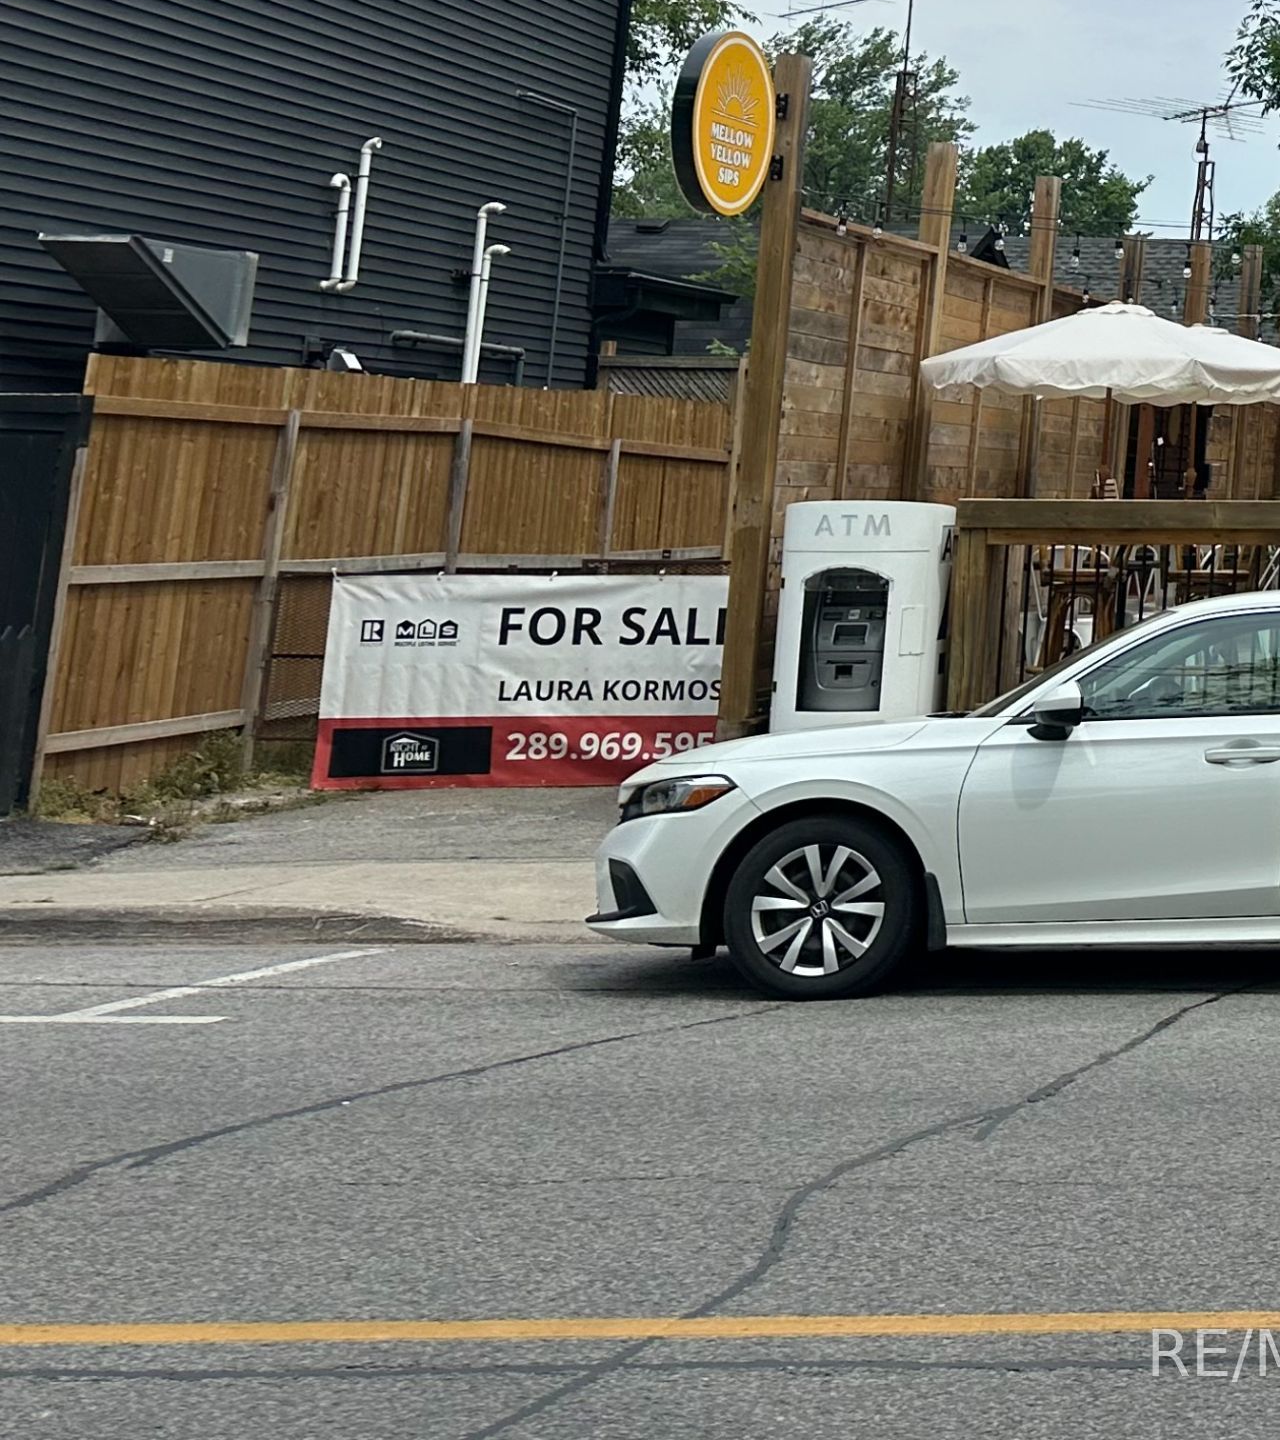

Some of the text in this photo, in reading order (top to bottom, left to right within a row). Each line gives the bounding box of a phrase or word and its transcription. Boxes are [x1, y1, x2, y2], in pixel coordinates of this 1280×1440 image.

[711, 122, 754, 149] MELLOW
[710, 143, 752, 169] YELLOW
[718, 166, 740, 187] SIPS
[814, 514, 891, 536] ATM
[498, 607, 604, 646] FOR
[498, 679, 722, 701] LAURA KORMOS
[393, 751, 431, 767] HOME
